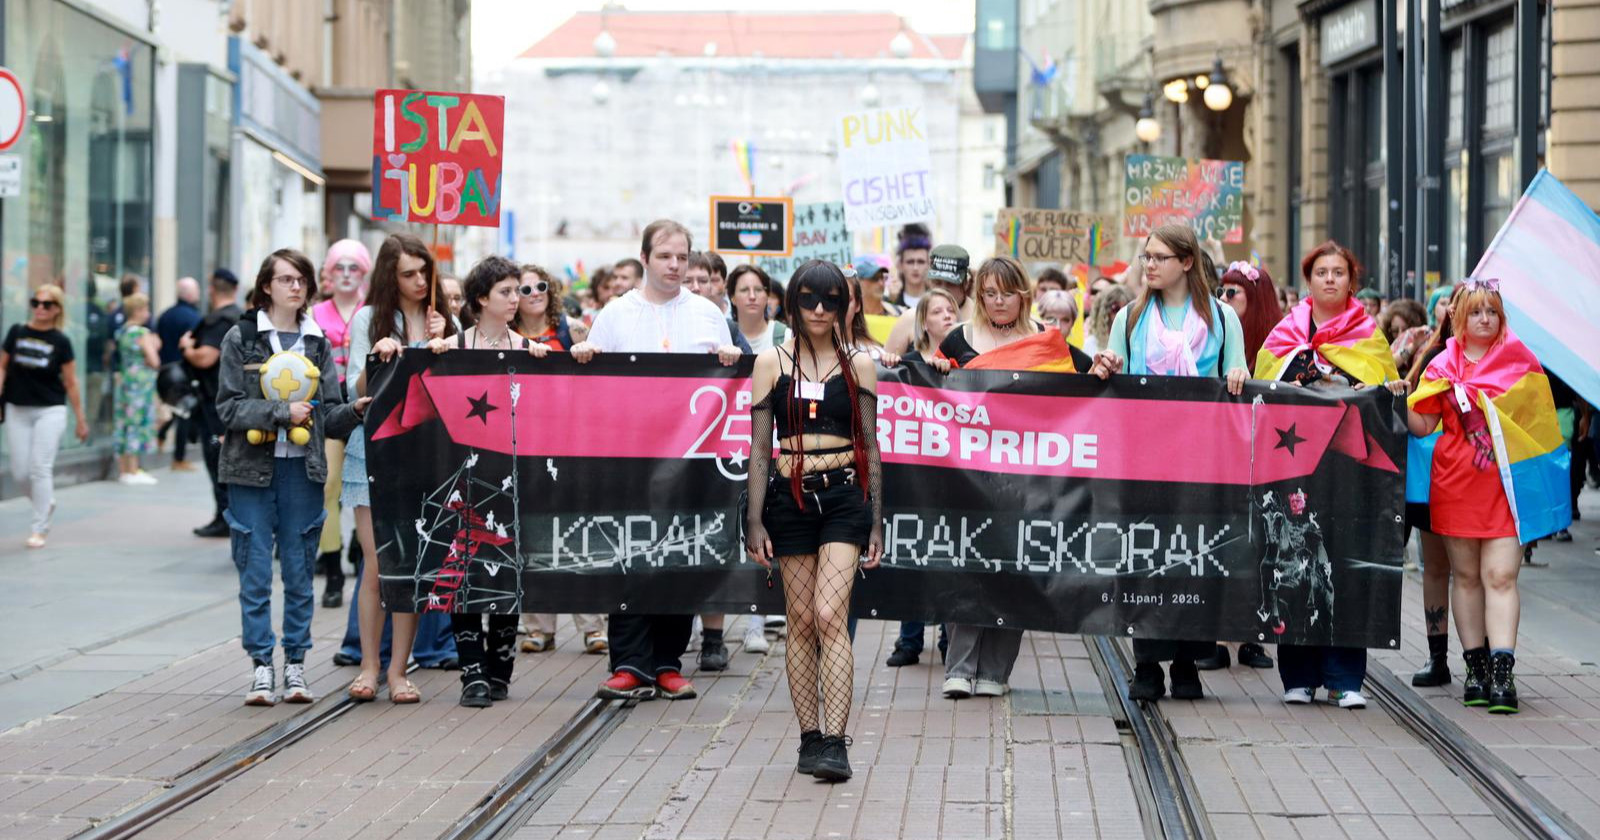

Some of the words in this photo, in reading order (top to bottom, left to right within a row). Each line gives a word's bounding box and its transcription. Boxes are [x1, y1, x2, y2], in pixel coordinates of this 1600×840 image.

[384, 92, 497, 157] ISTA
[842, 107, 926, 149] PUNK
[372, 154, 502, 222] LJUBAV
[846, 170, 928, 206] CISHET
[1201, 164, 1243, 188] NIJE
[1024, 236, 1085, 263] QUEER
[877, 394, 990, 425] PONOSA
[960, 427, 1098, 468] PRIDE
[552, 514, 726, 568] KORAK
[1016, 519, 1230, 577] ISKORAK
[1101, 592, 1114, 603] 6.
[1122, 593, 1164, 606] lipanj
[1171, 594, 1206, 604] 2026.
